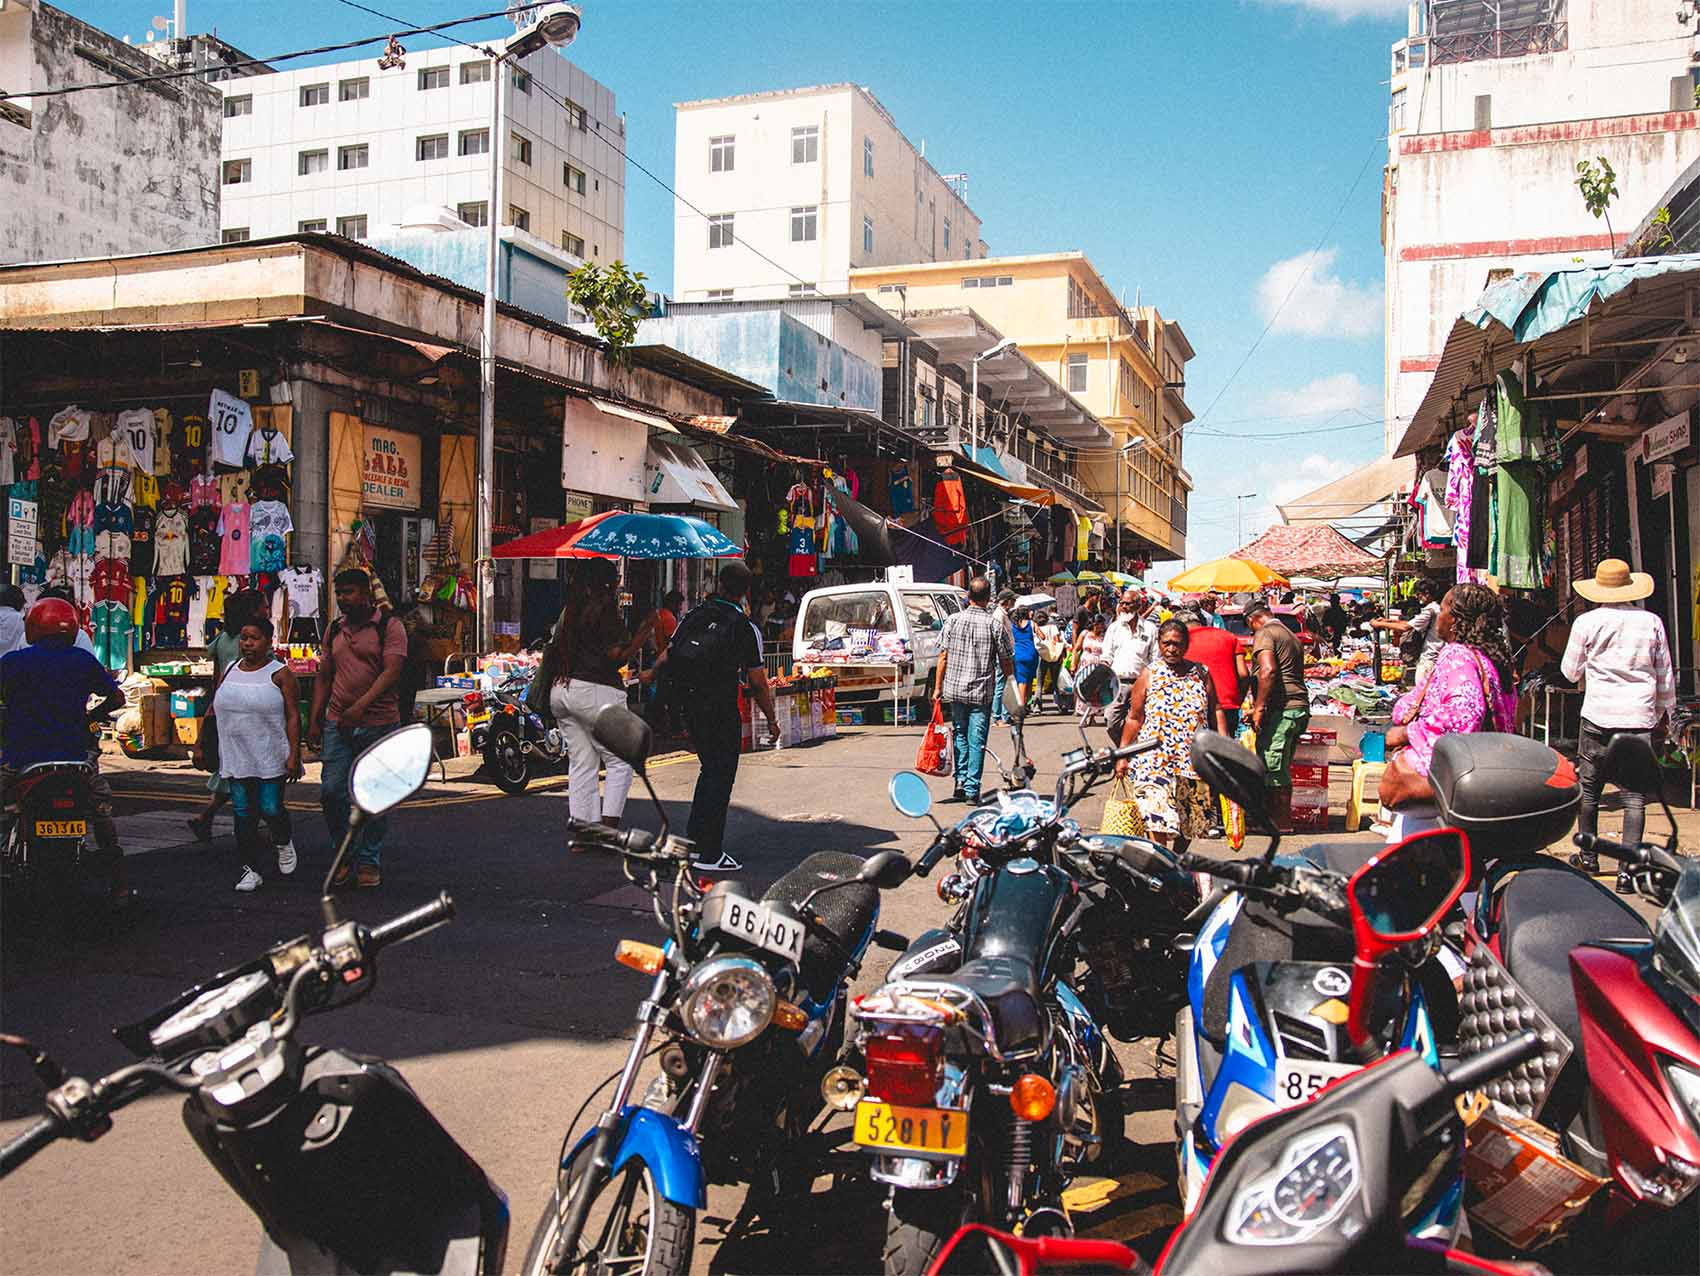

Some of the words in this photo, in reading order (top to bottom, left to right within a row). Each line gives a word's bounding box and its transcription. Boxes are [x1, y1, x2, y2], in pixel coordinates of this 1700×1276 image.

[216, 410, 238, 435] 10
[184, 425, 202, 448] 10
[799, 537, 806, 548] 3
[169, 587, 183, 604] 10
[1286, 1072, 1336, 1100] 85
